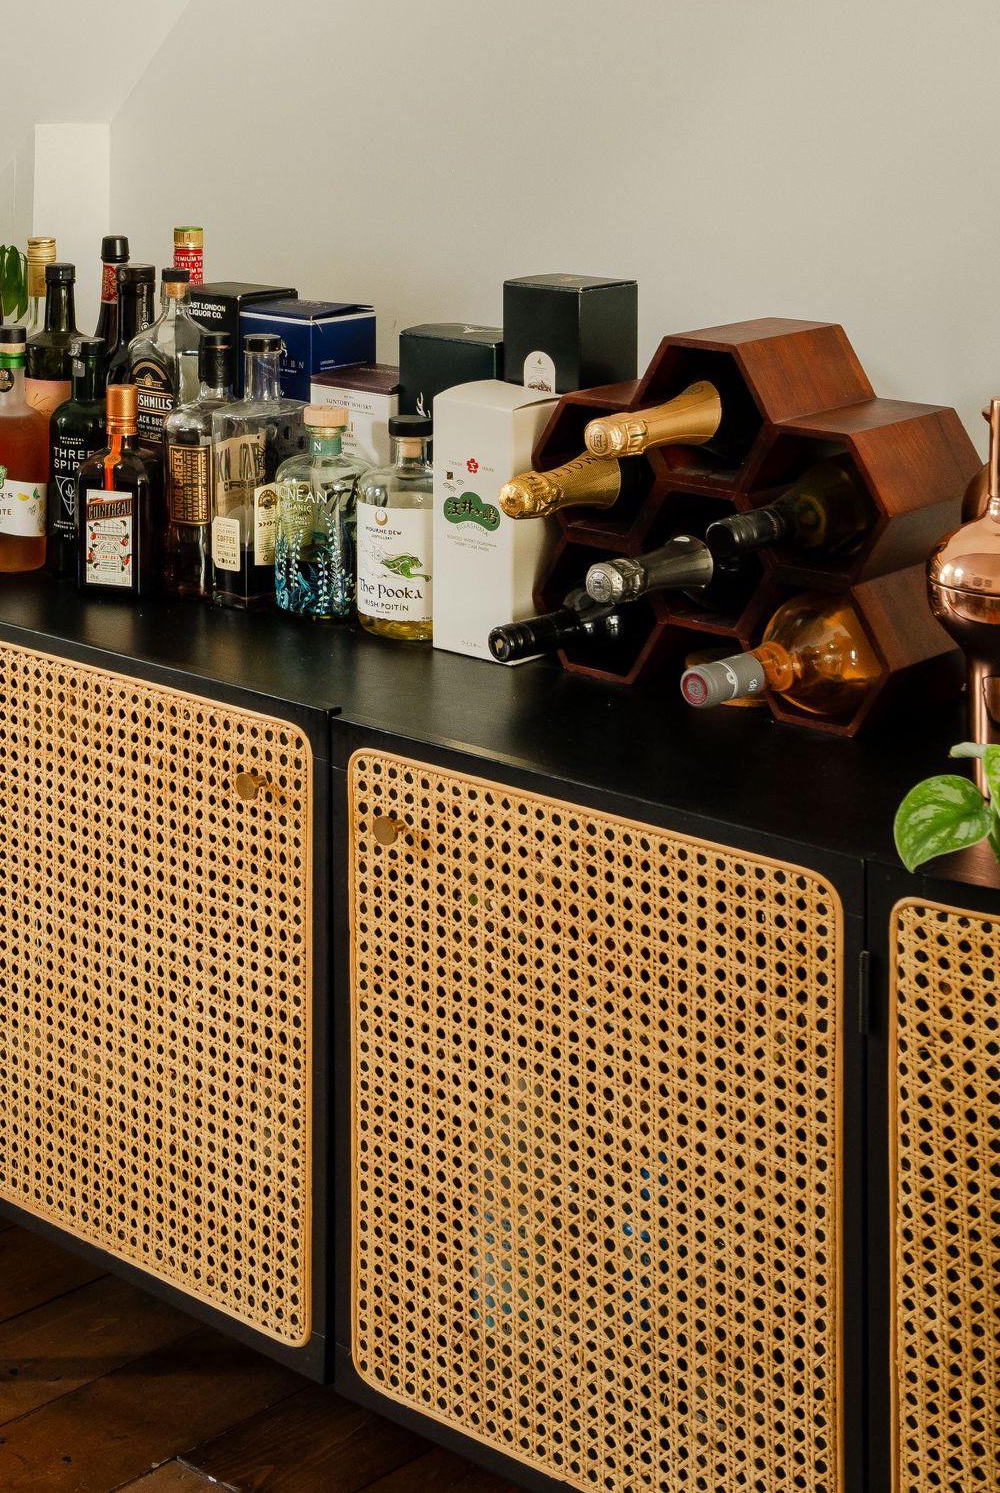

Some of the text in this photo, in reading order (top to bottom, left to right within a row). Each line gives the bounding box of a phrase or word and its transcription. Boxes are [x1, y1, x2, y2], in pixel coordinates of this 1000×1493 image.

[189, 302, 226, 312] AST LONDON
[189, 308, 223, 319] LIQUOR CO.
[138, 394, 172, 411] SHMILLS
[326, 398, 350, 406] SUNTORY
[139, 414, 162, 426] ACK BUS
[54, 458, 80, 471] SPIR
[174, 450, 184, 519] KNOB CREEK
[88, 499, 132, 520] COINTREAU
[456, 522, 489, 537] EIGASHIMA
[217, 534, 236, 544] COFFEE
[218, 557, 236, 565] VODKA
[359, 577, 423, 599] The Pooka
[365, 598, 379, 608] IRISH
[381, 602, 409, 612] POITÍN
